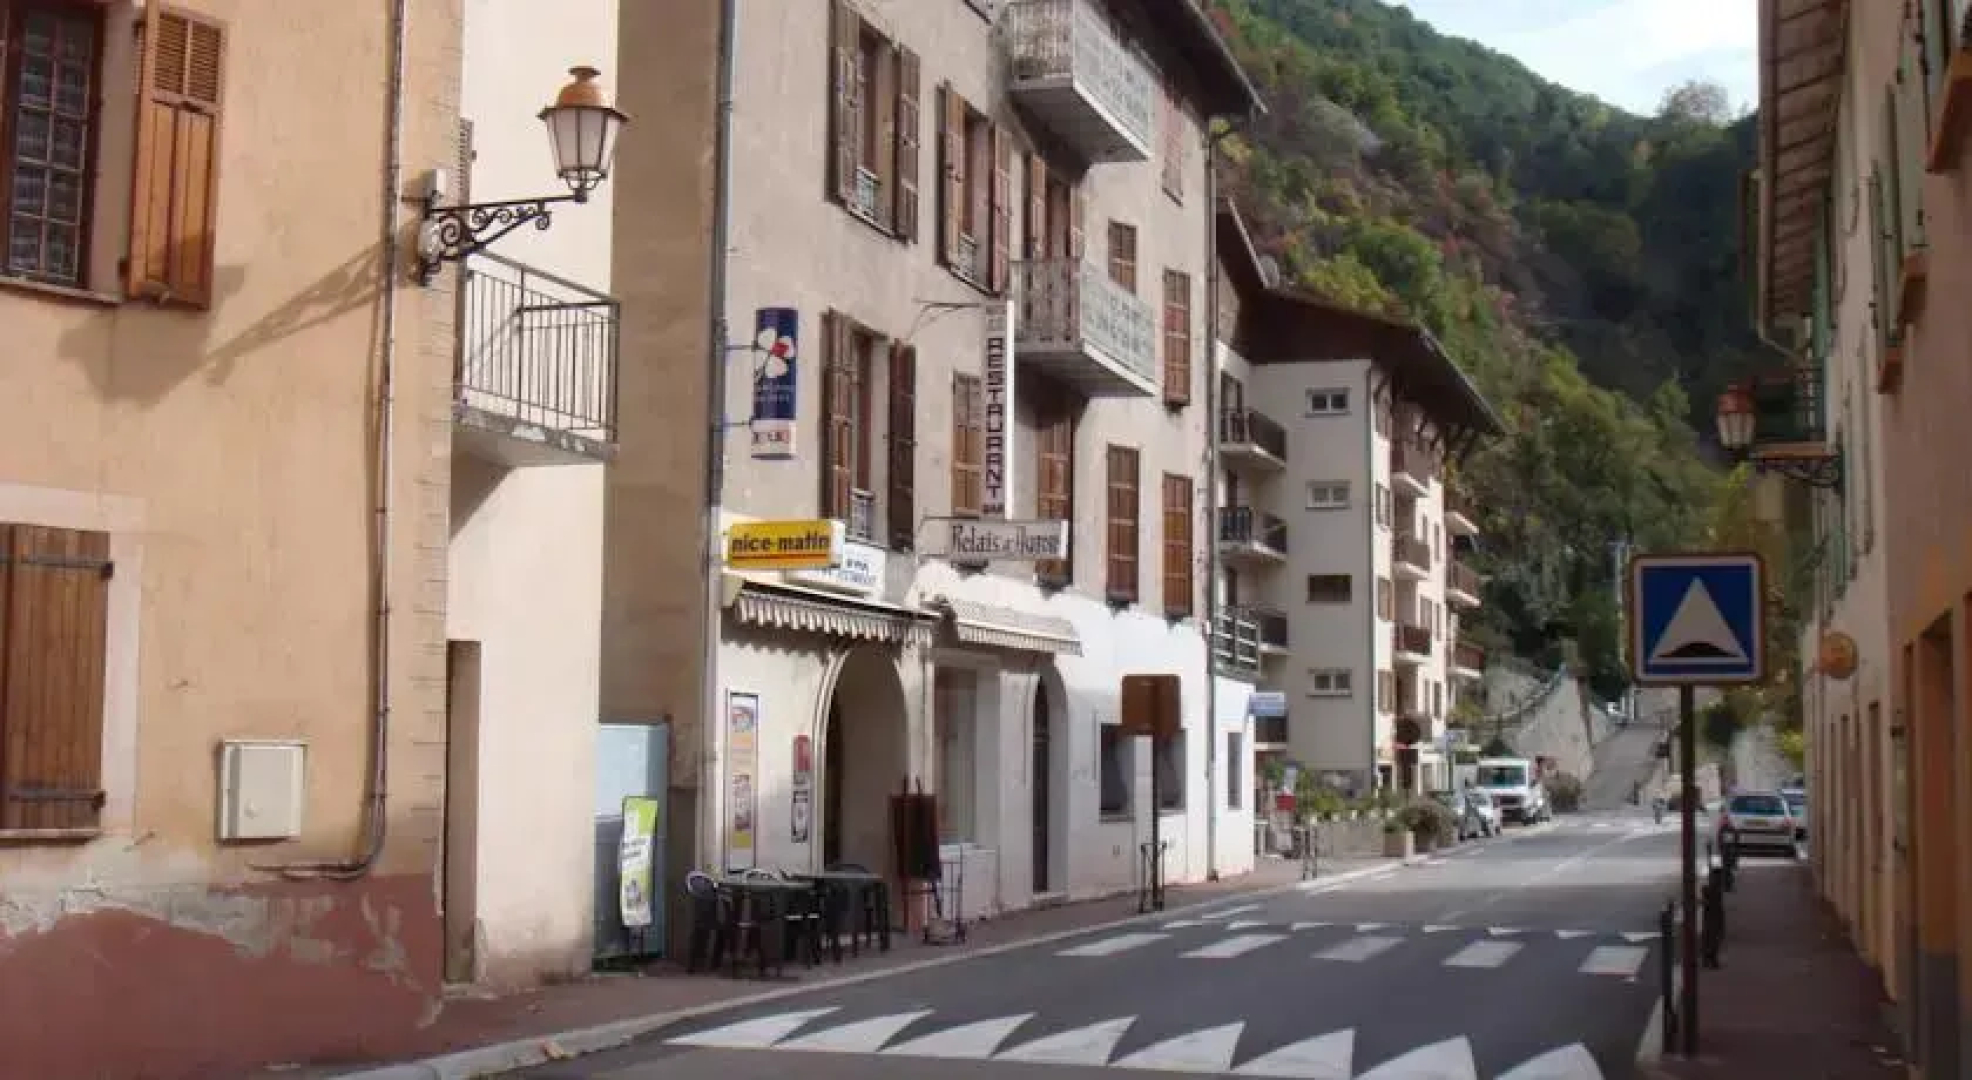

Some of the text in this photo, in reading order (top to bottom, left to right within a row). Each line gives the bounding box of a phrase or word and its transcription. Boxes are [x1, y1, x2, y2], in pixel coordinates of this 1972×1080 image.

[986, 337, 1003, 499] RESTAURANT
[731, 530, 830, 553] nice-matin
[952, 525, 1000, 553] Relais
